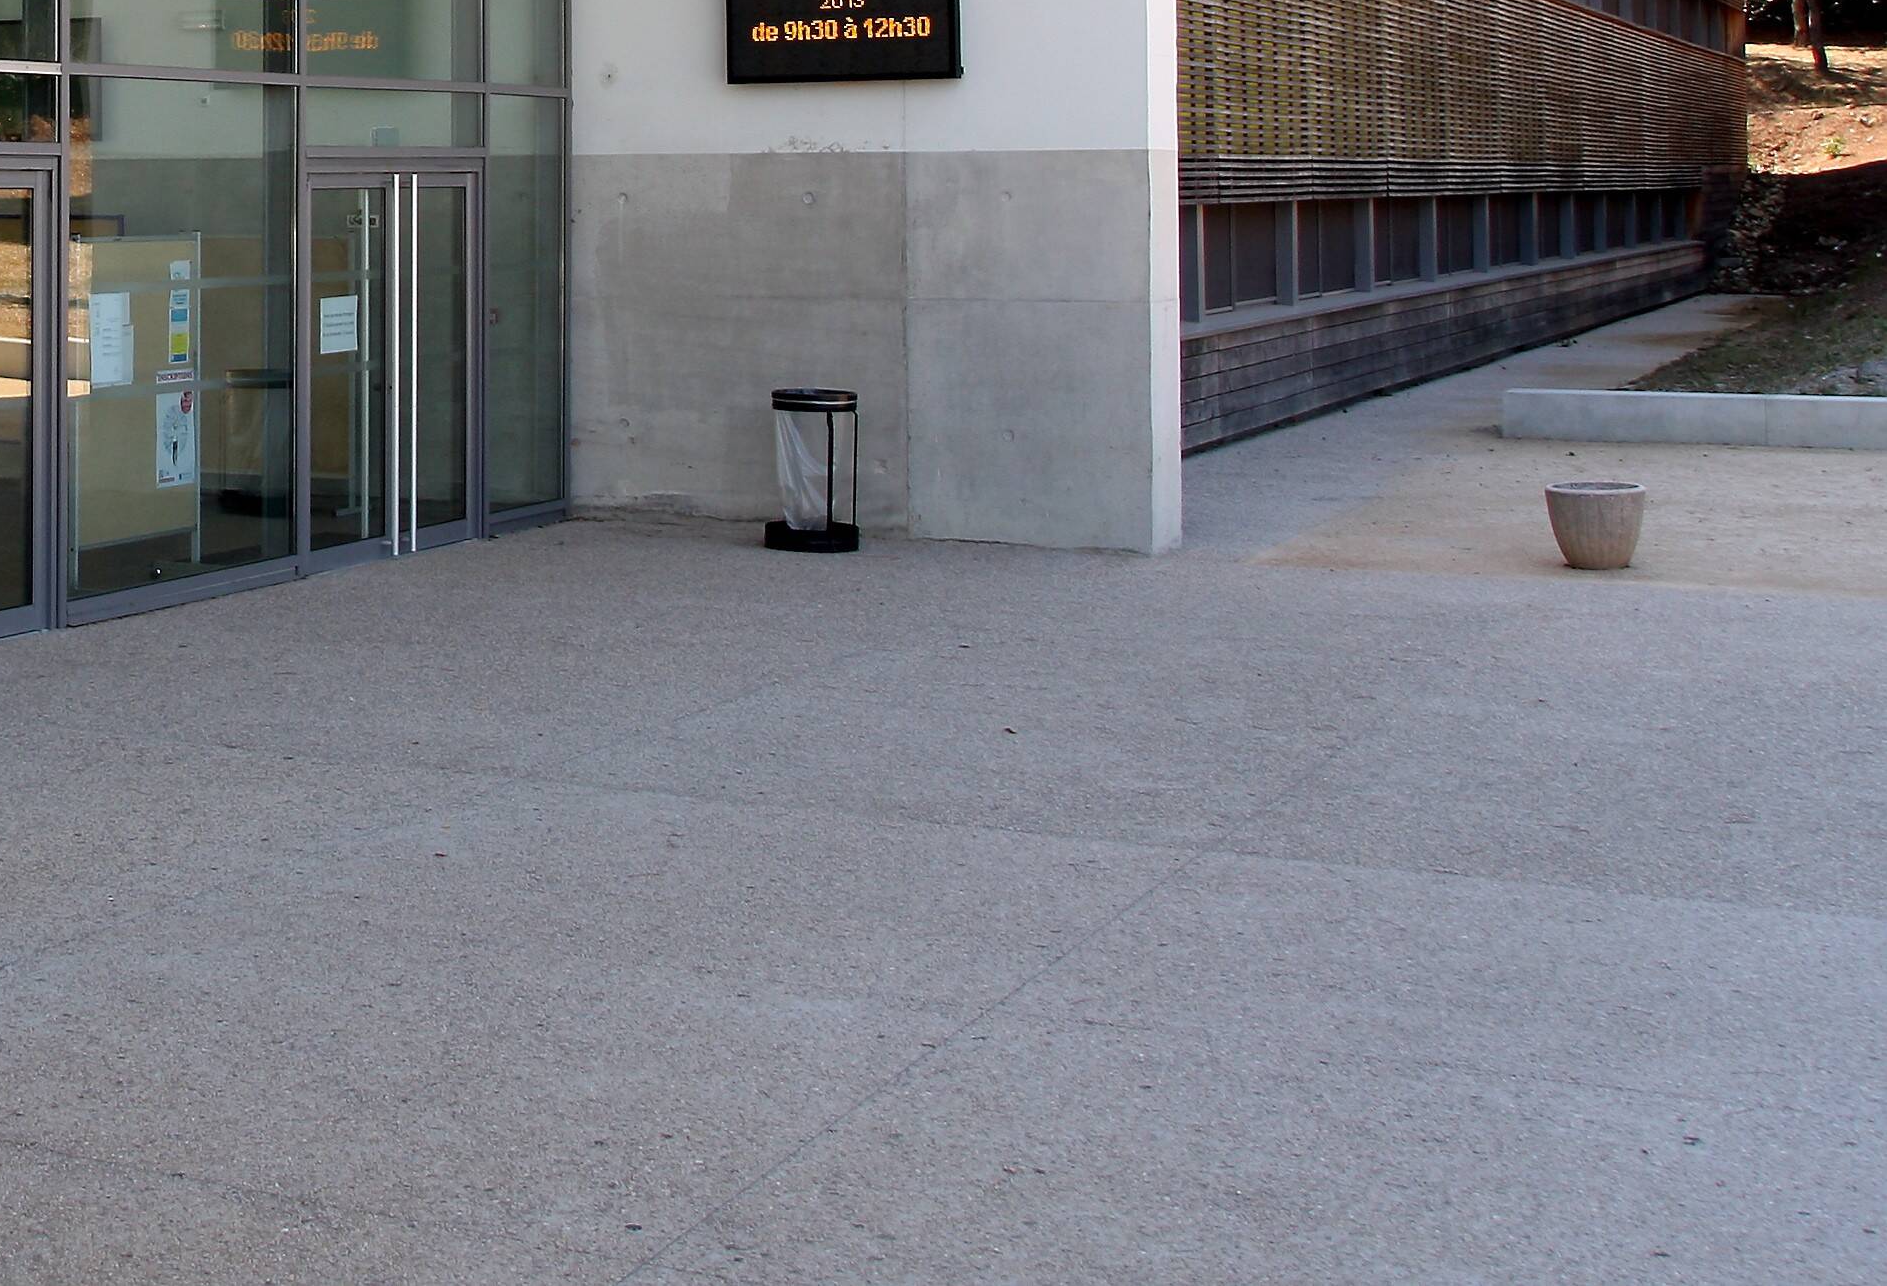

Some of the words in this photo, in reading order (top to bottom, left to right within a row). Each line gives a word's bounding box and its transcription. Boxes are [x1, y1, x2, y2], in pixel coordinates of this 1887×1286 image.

[752, 22, 779, 42] de
[784, 20, 840, 41] 9h30
[843, 17, 858, 39] à
[862, 17, 931, 39] 12h30
